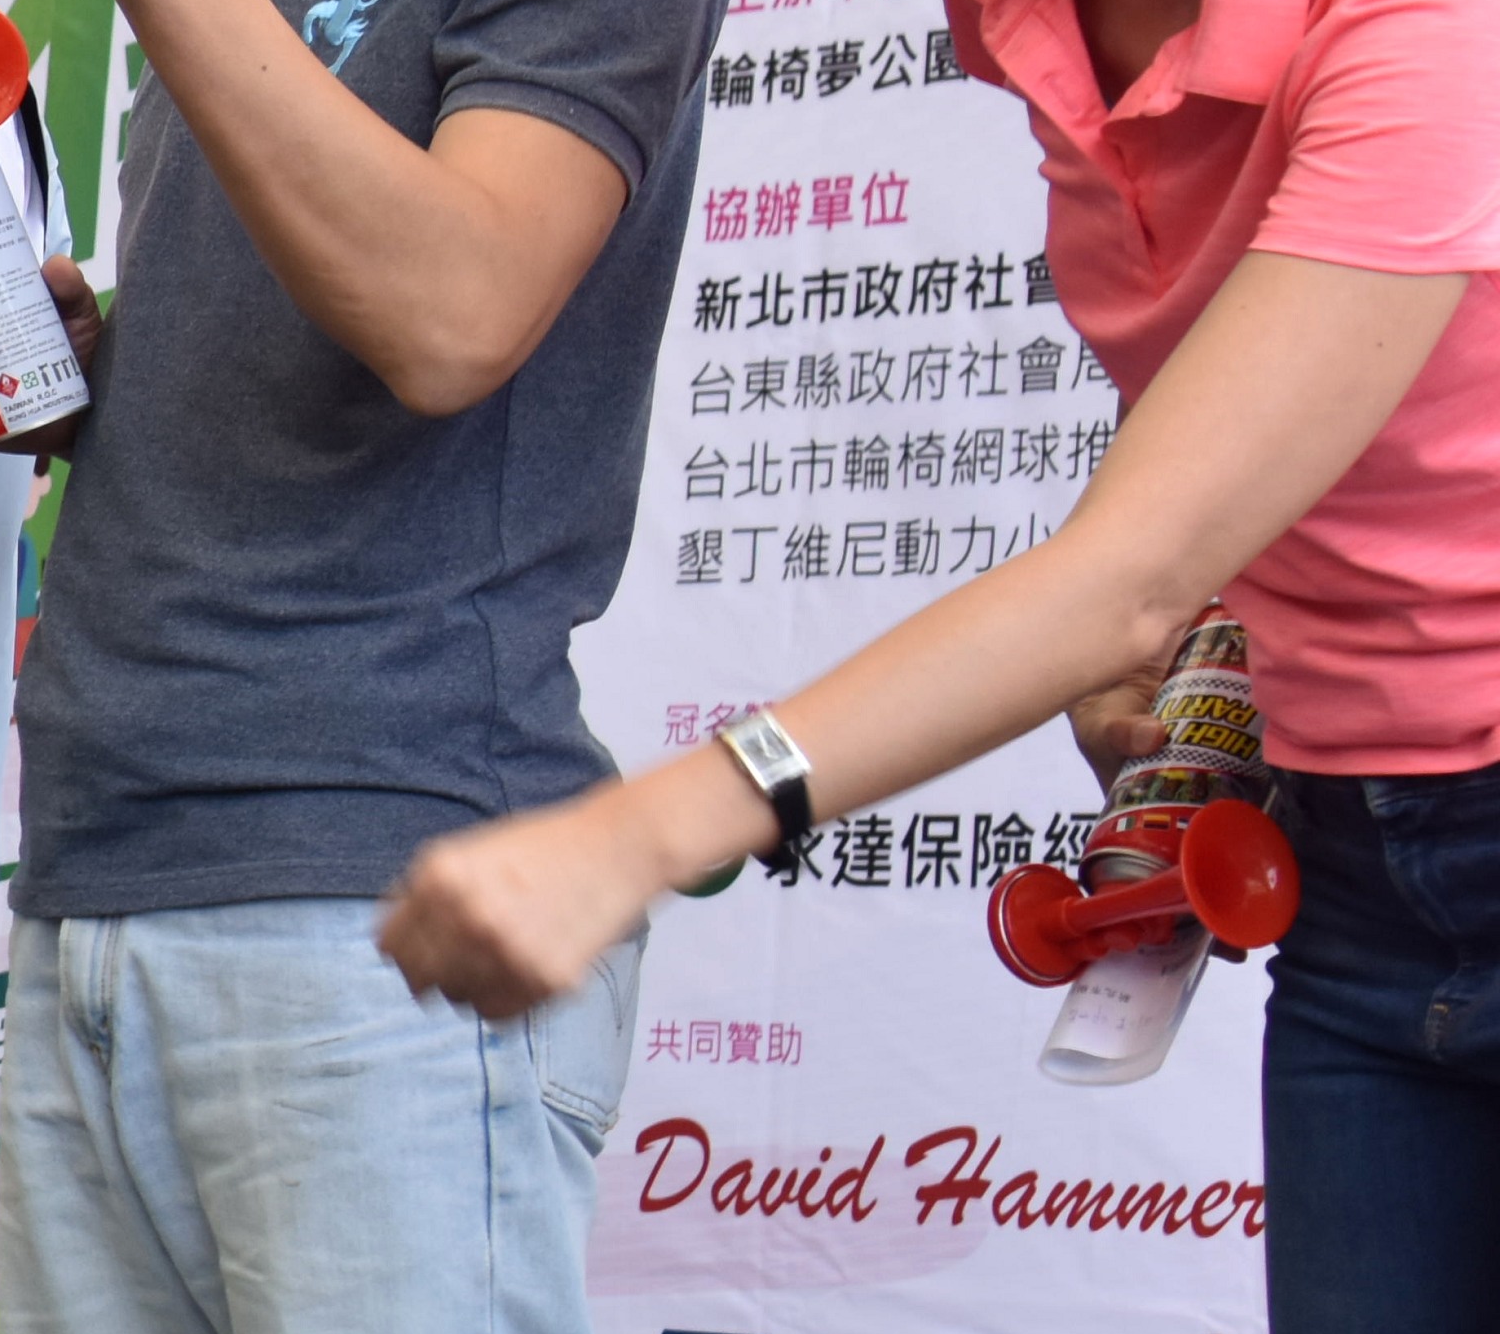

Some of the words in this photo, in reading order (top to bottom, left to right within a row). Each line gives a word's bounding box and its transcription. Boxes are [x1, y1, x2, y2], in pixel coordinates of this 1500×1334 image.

[708, 28, 968, 109] 輪椅夢公園
[704, 169, 910, 243] 協辦單位
[1201, 719, 1262, 763] HIGH
[646, 1020, 803, 1065] 共同贊助
[634, 1116, 886, 1223] David
[903, 1125, 1266, 1238] Hammer
